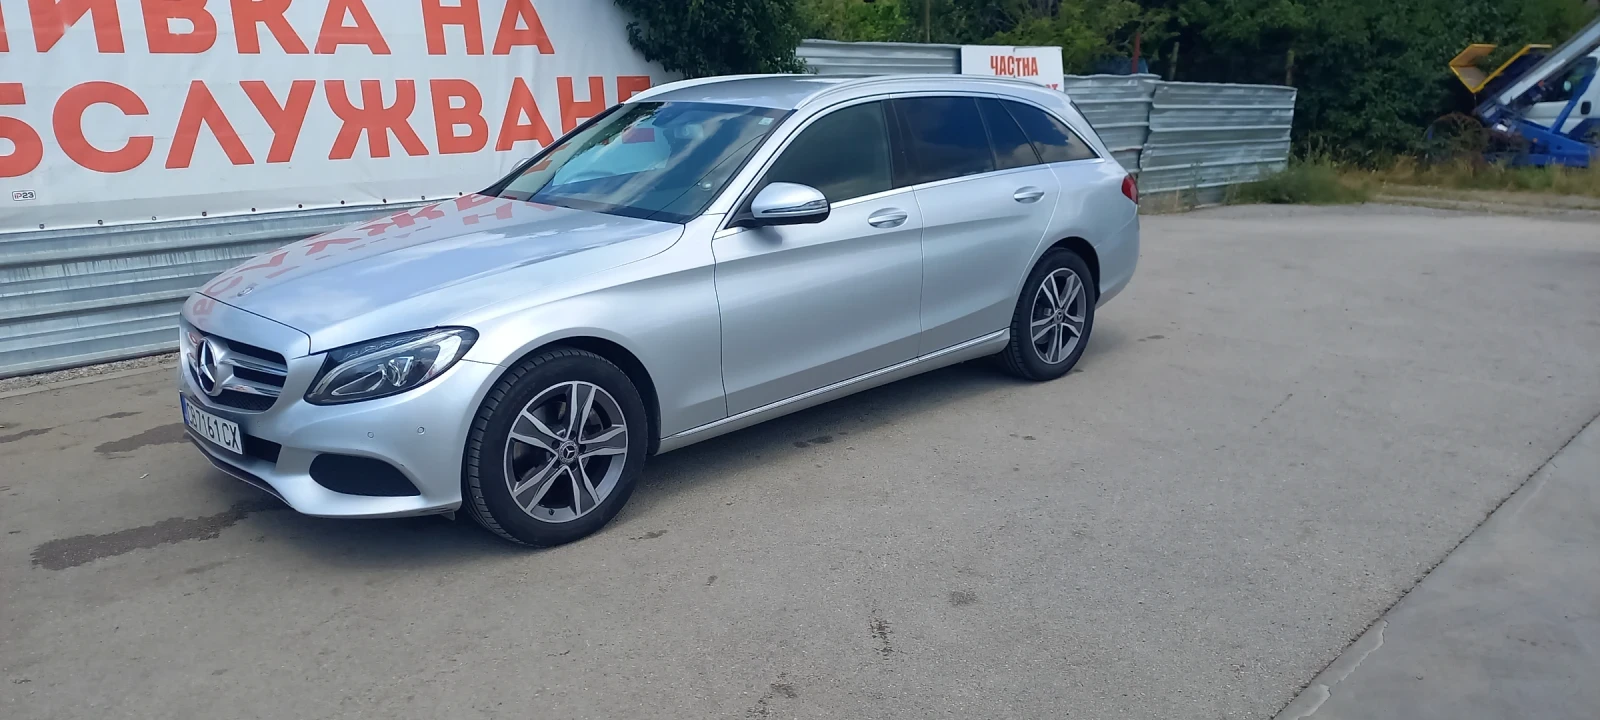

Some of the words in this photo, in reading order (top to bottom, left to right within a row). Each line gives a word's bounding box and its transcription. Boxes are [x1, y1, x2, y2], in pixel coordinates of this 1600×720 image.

[0, 0, 391, 54] ИВКА
[421, 0, 555, 55] НА
[990, 55, 1038, 76] ЧАСТНА
